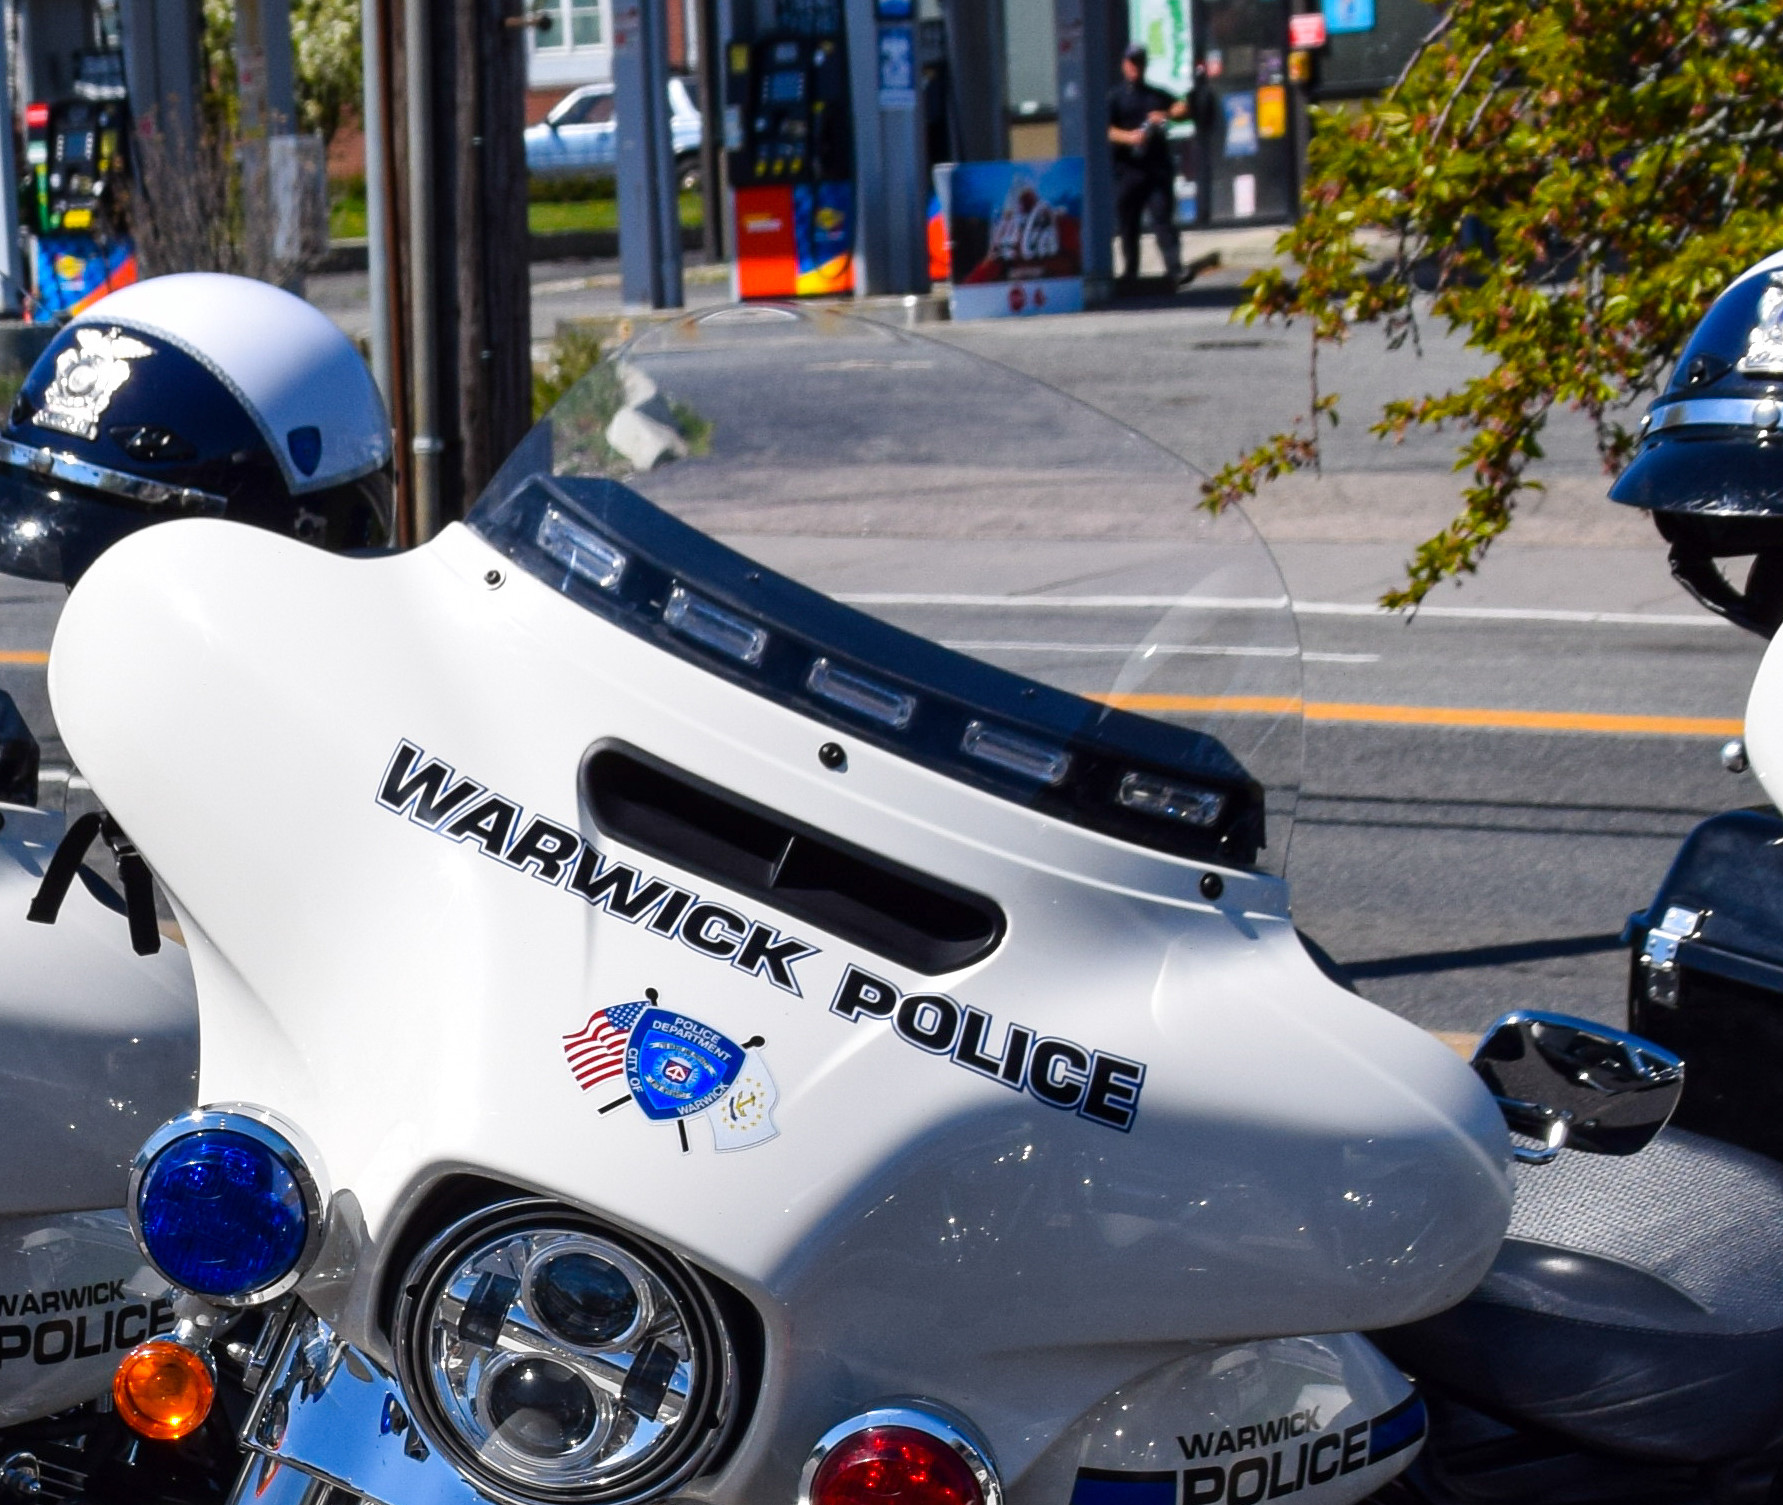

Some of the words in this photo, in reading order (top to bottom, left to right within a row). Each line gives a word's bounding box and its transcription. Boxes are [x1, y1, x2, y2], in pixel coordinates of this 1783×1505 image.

[375, 738, 821, 997] WARWICK
[830, 963, 1146, 1132] POLICE
[652, 1020, 732, 1062] DEPARTMENT
[674, 1016, 722, 1045] POLICE
[627, 1047, 639, 1075] CITY
[630, 1079, 644, 1093] OF
[676, 1081, 730, 1116] WARWICK
[1176, 1405, 1321, 1460] WARWICK
